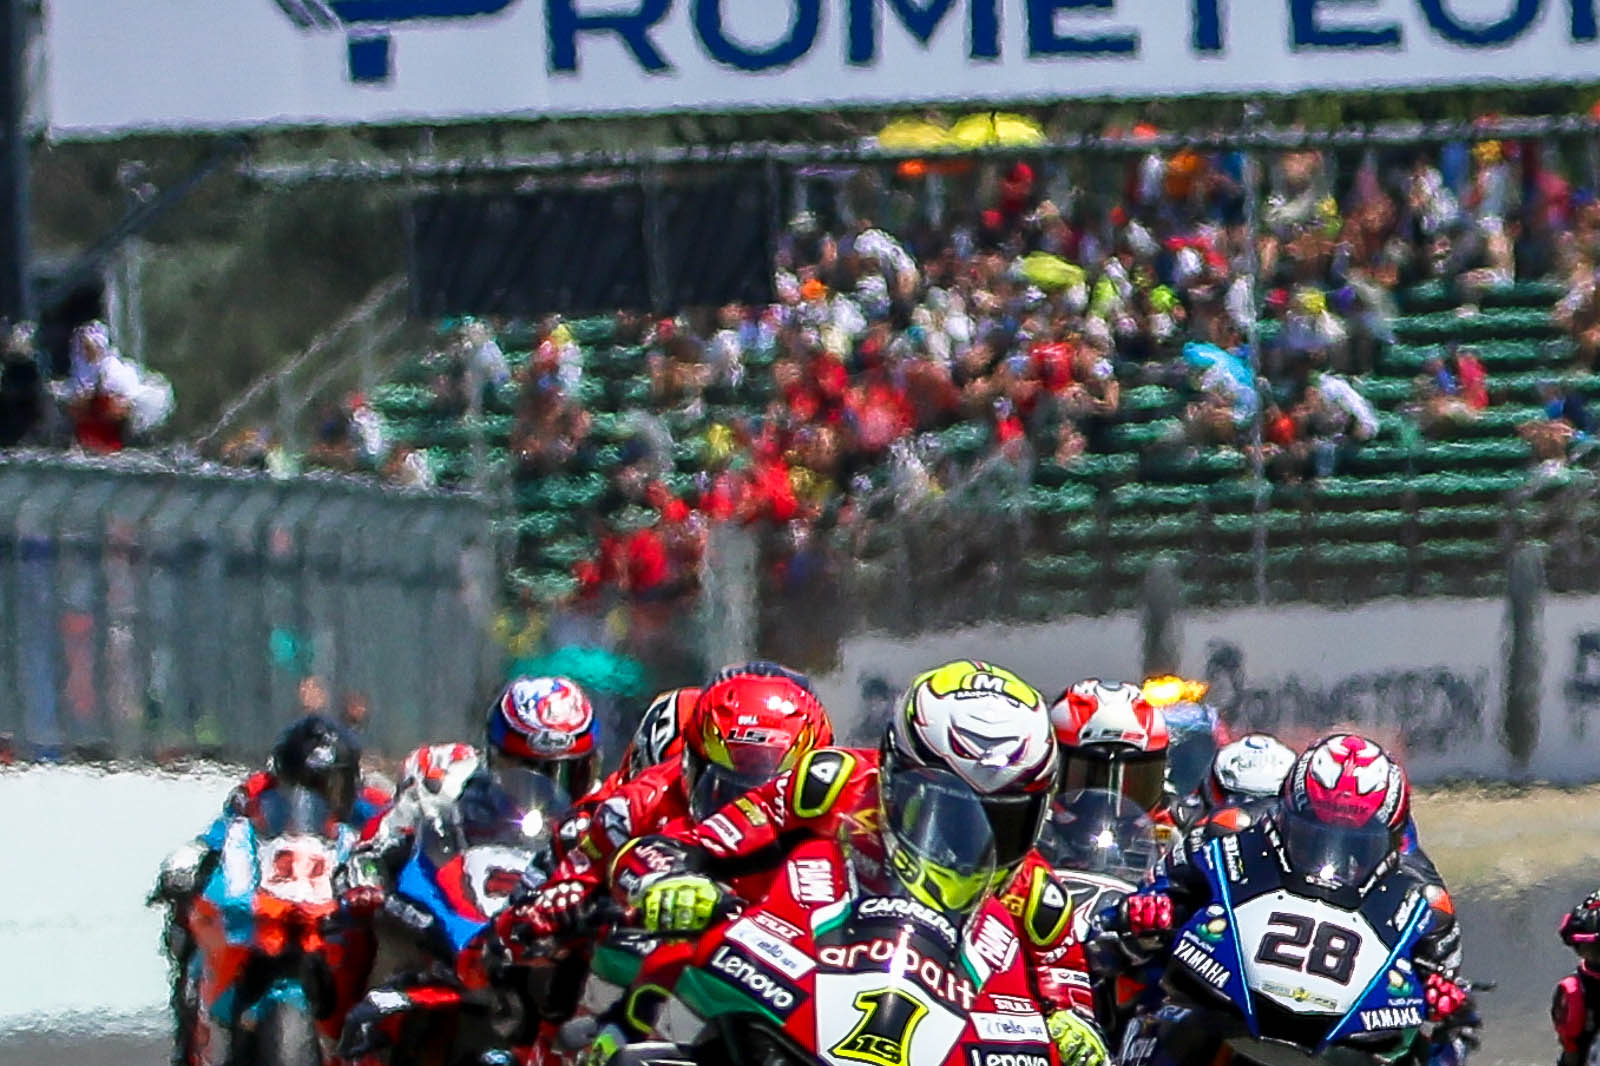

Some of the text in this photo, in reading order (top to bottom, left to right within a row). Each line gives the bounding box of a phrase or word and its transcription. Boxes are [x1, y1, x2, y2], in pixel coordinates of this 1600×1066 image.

[859, 897, 958, 948] CARRERA
[1254, 911, 1364, 987] 28
[711, 945, 794, 1009] Lenovo
[818, 937, 978, 1011] aruba.it
[1173, 939, 1231, 989] YAMAHA
[1360, 1007, 1422, 1031] YAMAHA
